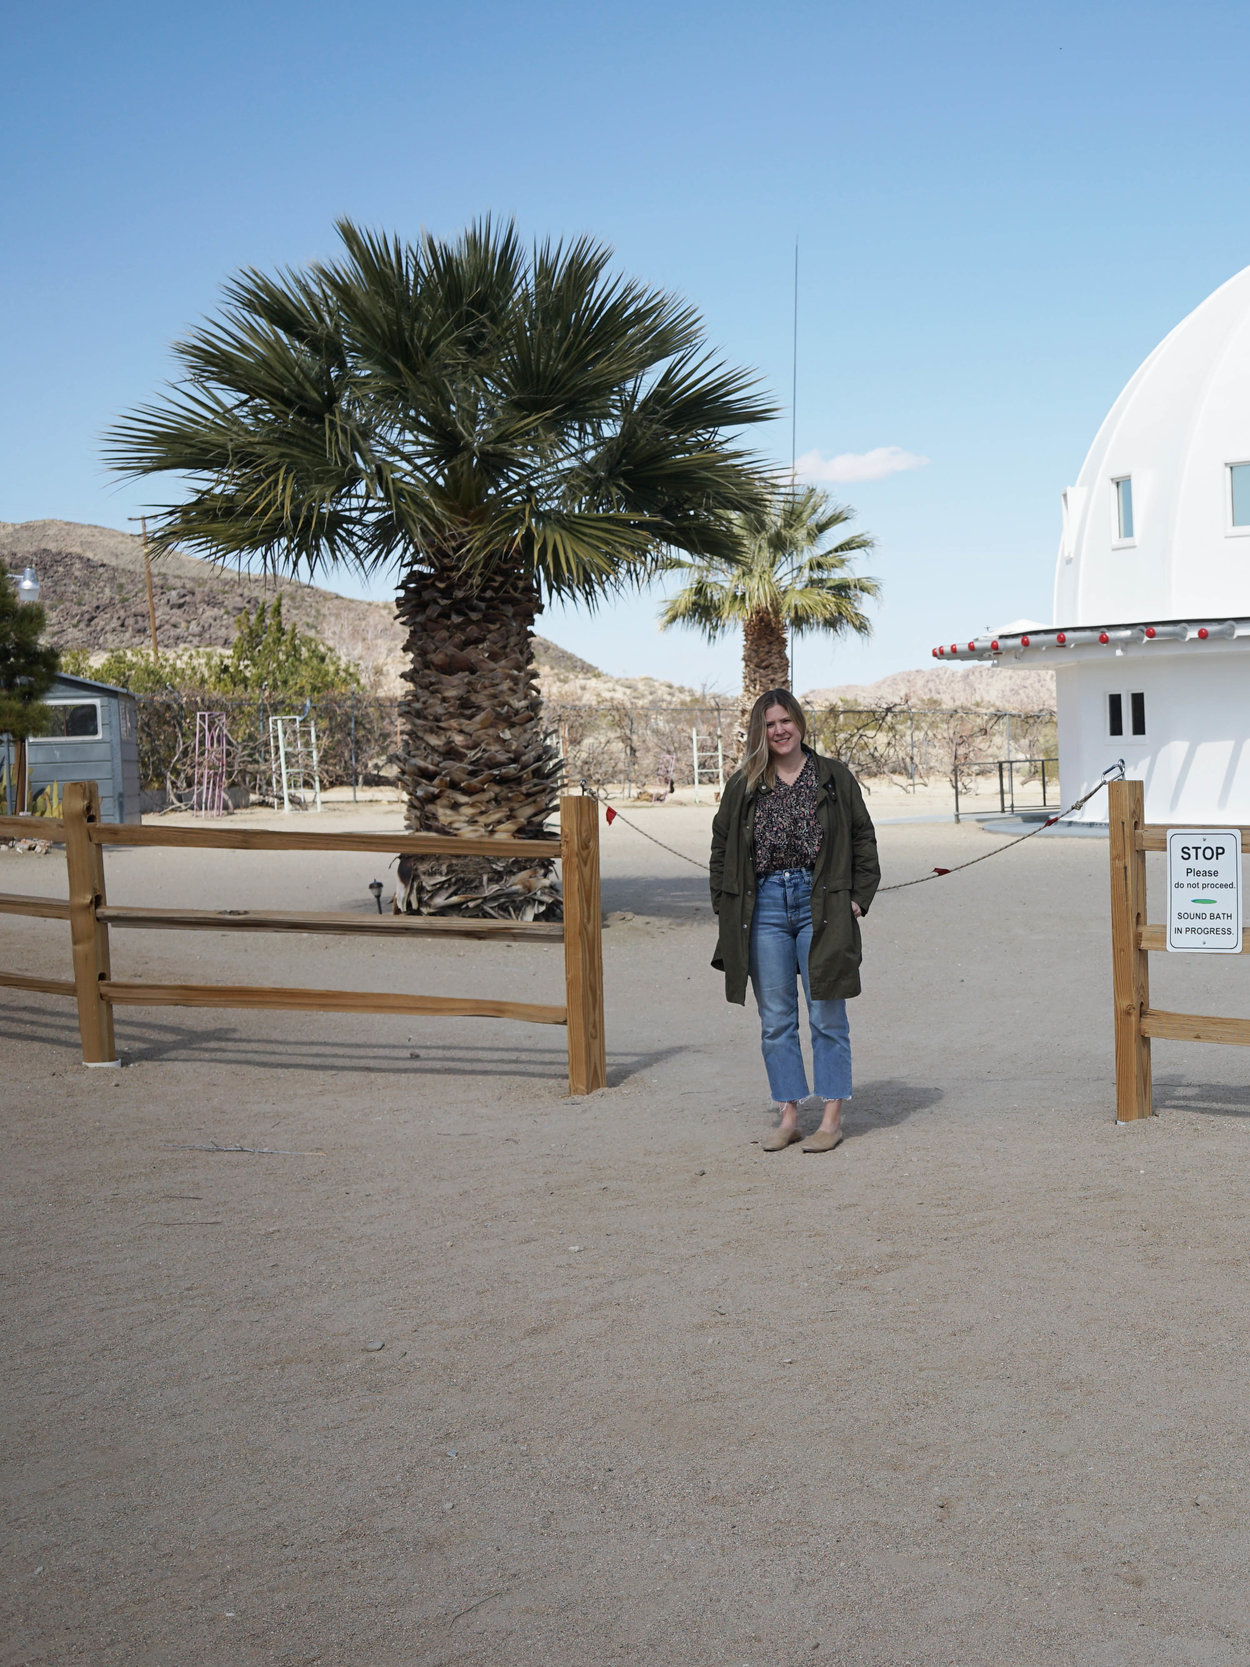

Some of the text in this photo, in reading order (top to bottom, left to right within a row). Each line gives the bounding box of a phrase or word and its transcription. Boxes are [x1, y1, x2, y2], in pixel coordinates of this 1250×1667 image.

[1180, 846, 1226, 861] STOP
[1185, 867, 1219, 878] Please
[1201, 882, 1236, 890] proceed.
[1177, 912, 1232, 920] SOUND BATH
[1174, 927, 1234, 935] IN PROGRESS.
